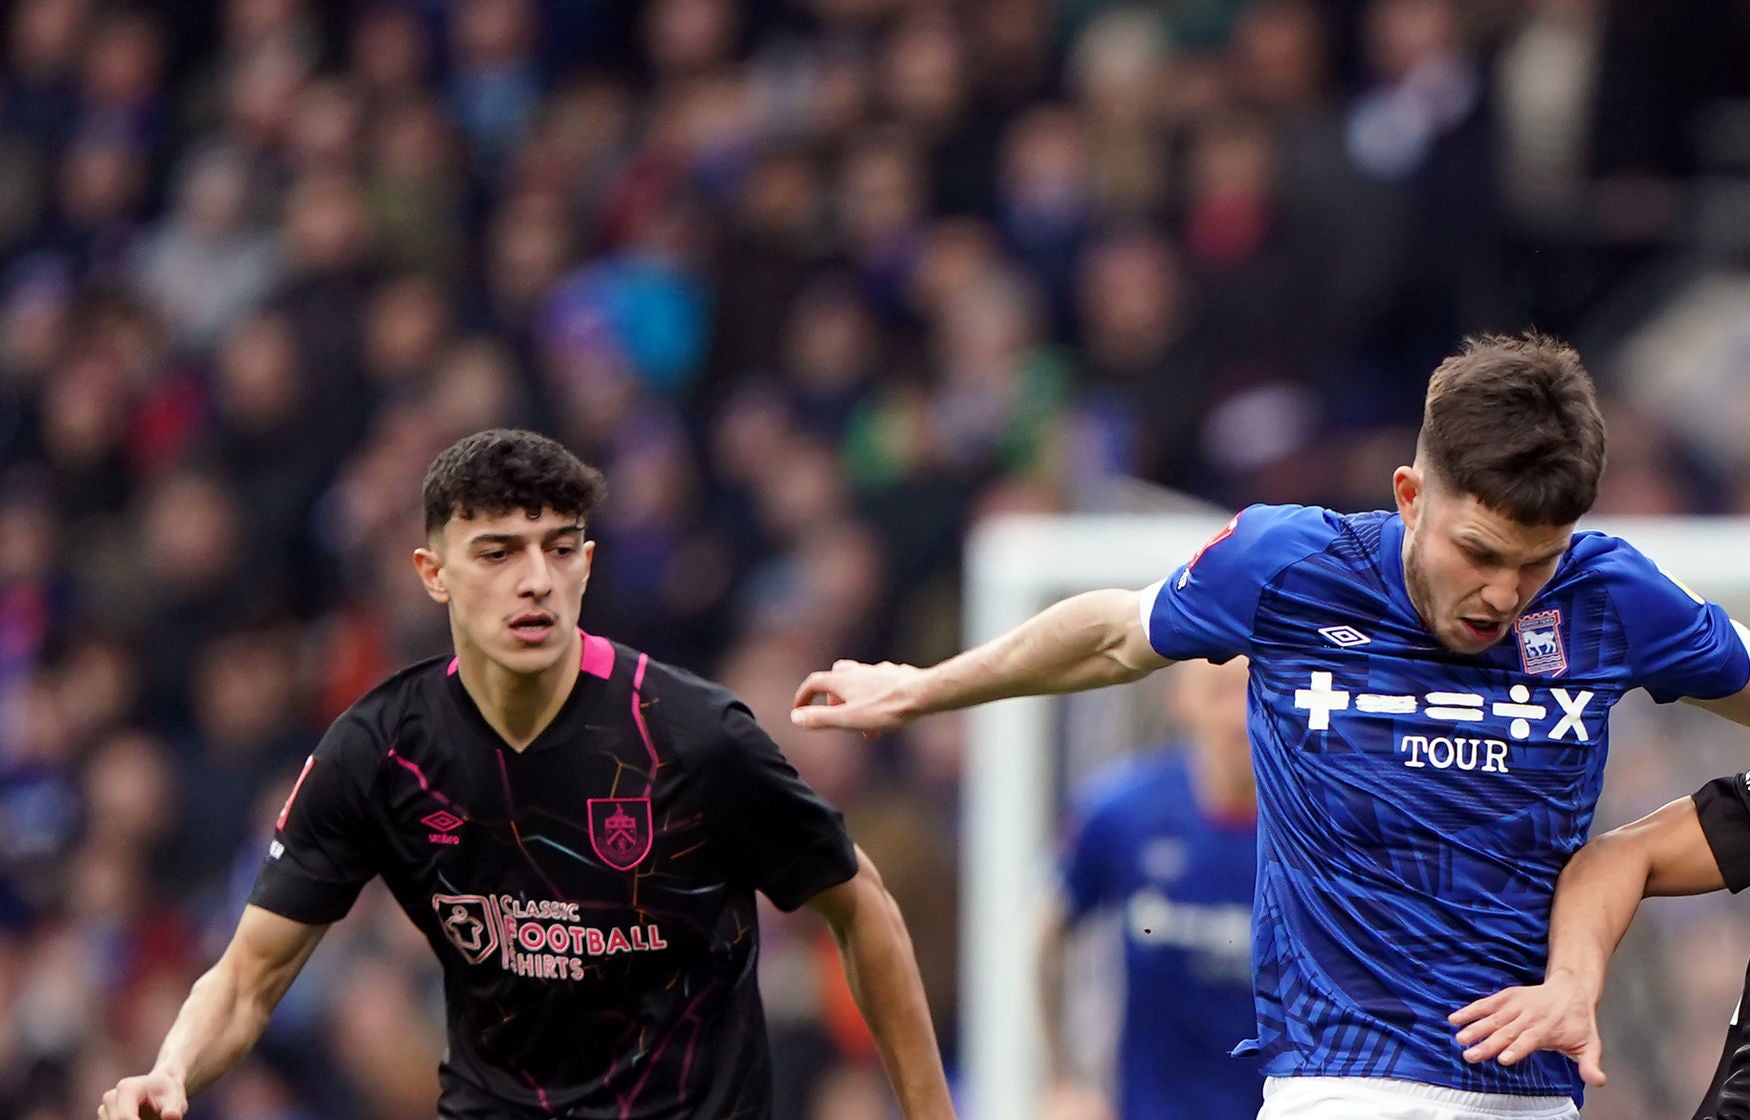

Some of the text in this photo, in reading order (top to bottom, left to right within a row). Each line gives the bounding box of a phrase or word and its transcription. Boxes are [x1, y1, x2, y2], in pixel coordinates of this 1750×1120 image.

[1400, 735, 1509, 773] TOUR
[500, 895, 581, 922] CLASSIC
[504, 915, 668, 955] FOOTBALL
